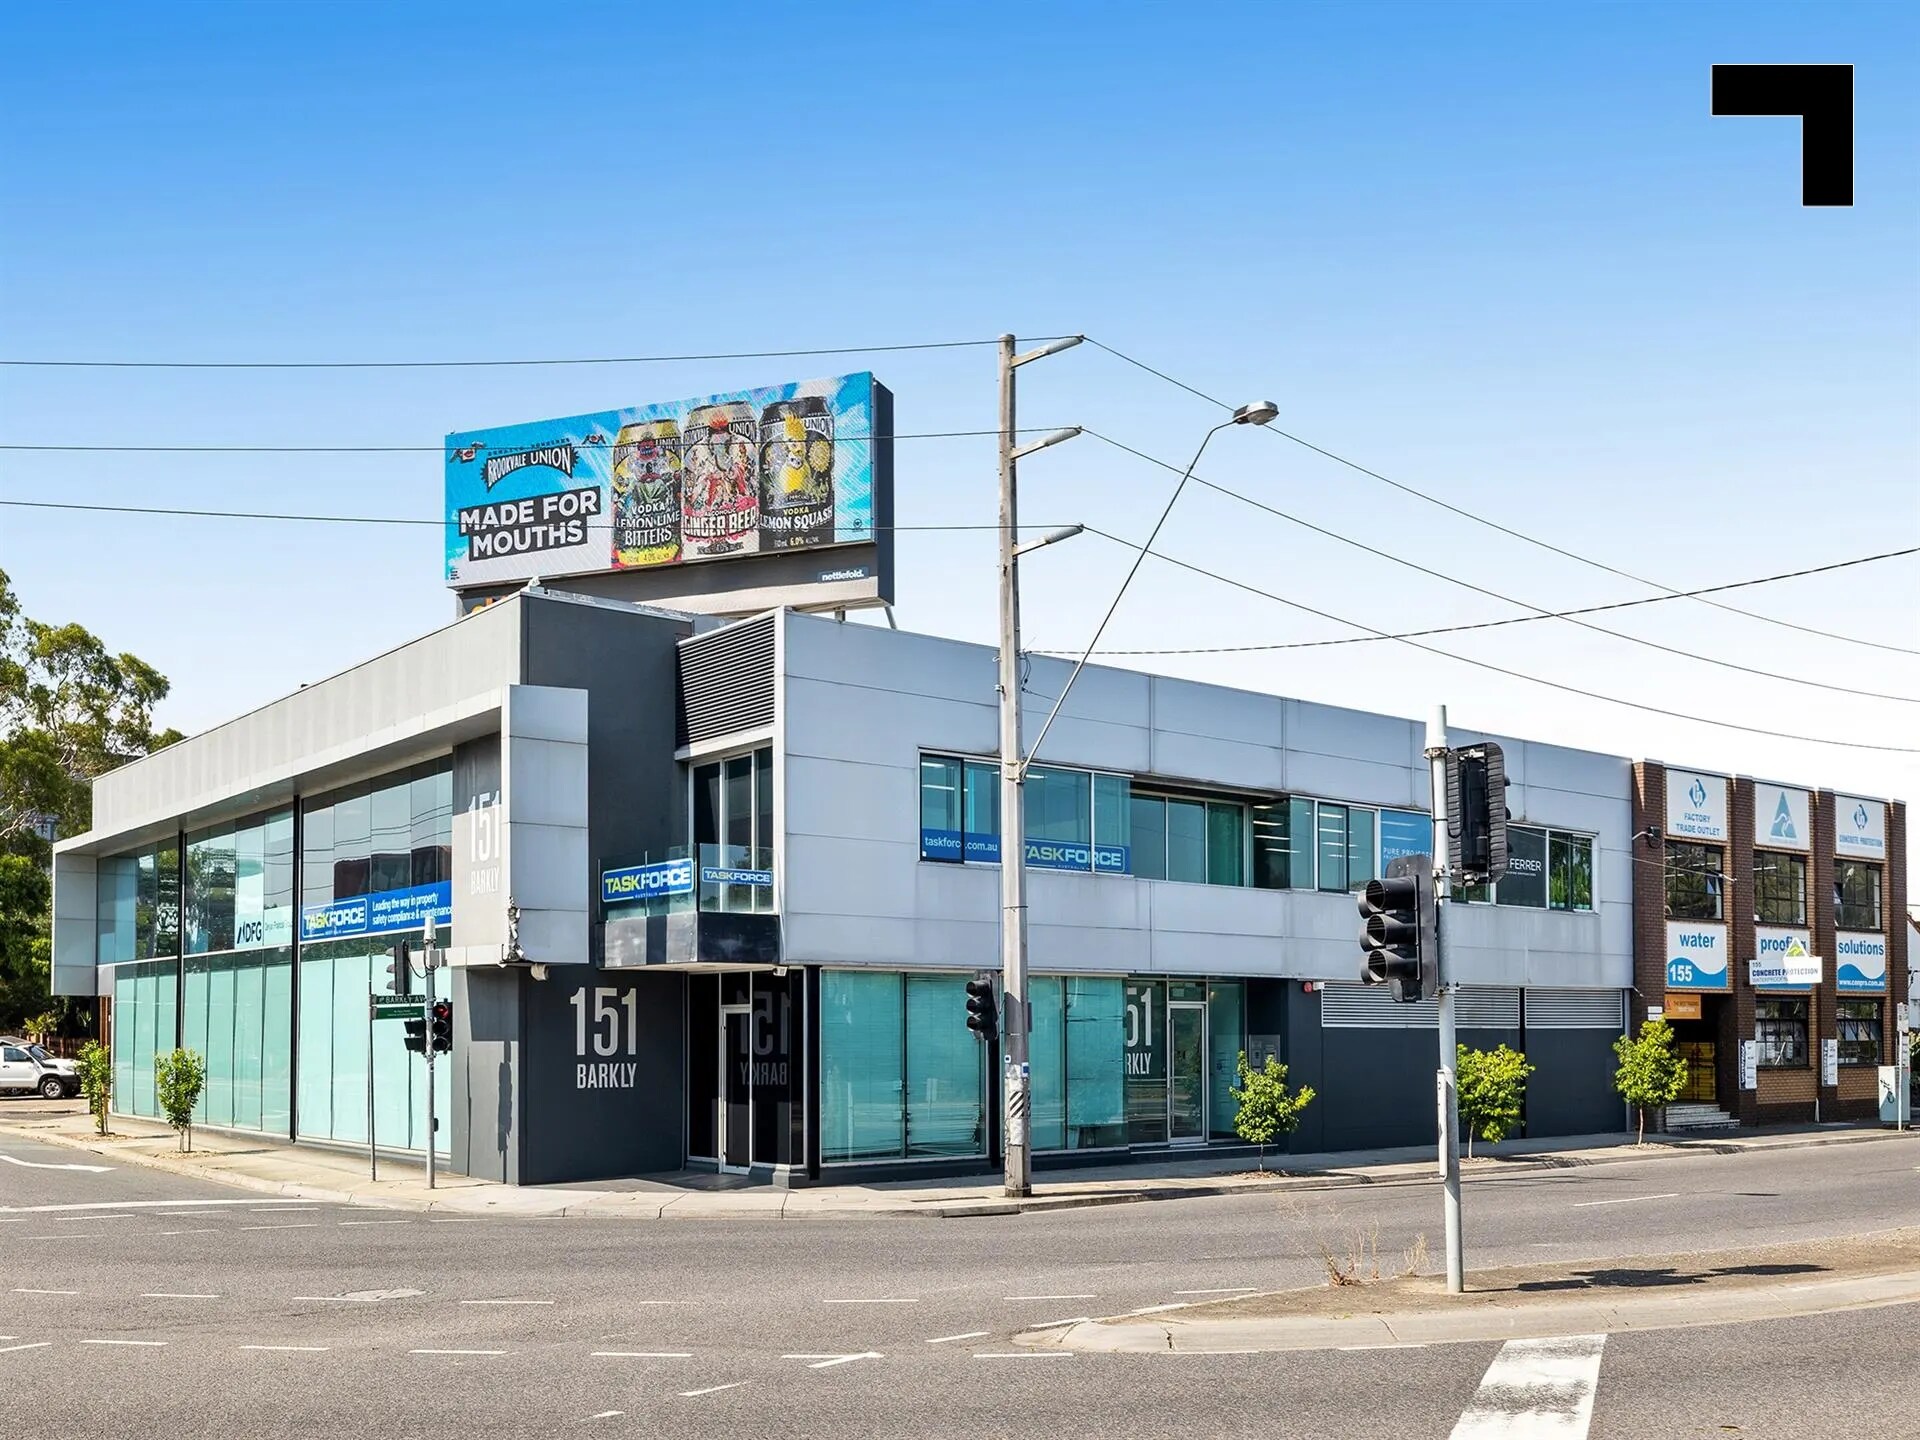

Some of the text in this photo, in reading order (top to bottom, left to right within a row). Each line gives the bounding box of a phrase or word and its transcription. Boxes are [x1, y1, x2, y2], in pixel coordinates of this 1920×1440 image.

[487, 453, 527, 488] BROOKVALE
[530, 445, 572, 475] UNION
[461, 490, 597, 534] MADE FOR
[632, 502, 666, 515] VODKA
[759, 504, 833, 532] LEMON SQUASH
[783, 506, 810, 516] VODKA
[616, 516, 657, 529] LEMON
[685, 515, 725, 537] GINGER
[473, 519, 583, 557] MOUTHS
[625, 526, 672, 547] BITTERS
[468, 790, 500, 863] 151
[1684, 812, 1711, 823] FACTORY
[1675, 823, 1720, 837] TRADE OUTLET
[1509, 857, 1542, 871] FERRER
[470, 865, 500, 896] BARKLY
[605, 866, 691, 894] TASKFORCE
[704, 869, 771, 883] TASKFORCE
[372, 892, 439, 912] Leading the way in property
[304, 906, 365, 931] TASKFORCE
[372, 914, 387, 926] safety
[387, 910, 416, 924] compliance
[1679, 932, 1716, 949] water
[1838, 939, 1884, 956] solutions
[1669, 964, 1693, 982] 155
[1752, 968, 1781, 977] CONCRETE
[570, 986, 638, 1057] 151
[1127, 987, 1152, 1048] 51
[1126, 1052, 1152, 1075] RKLY
[576, 1062, 637, 1090] BARKLY
